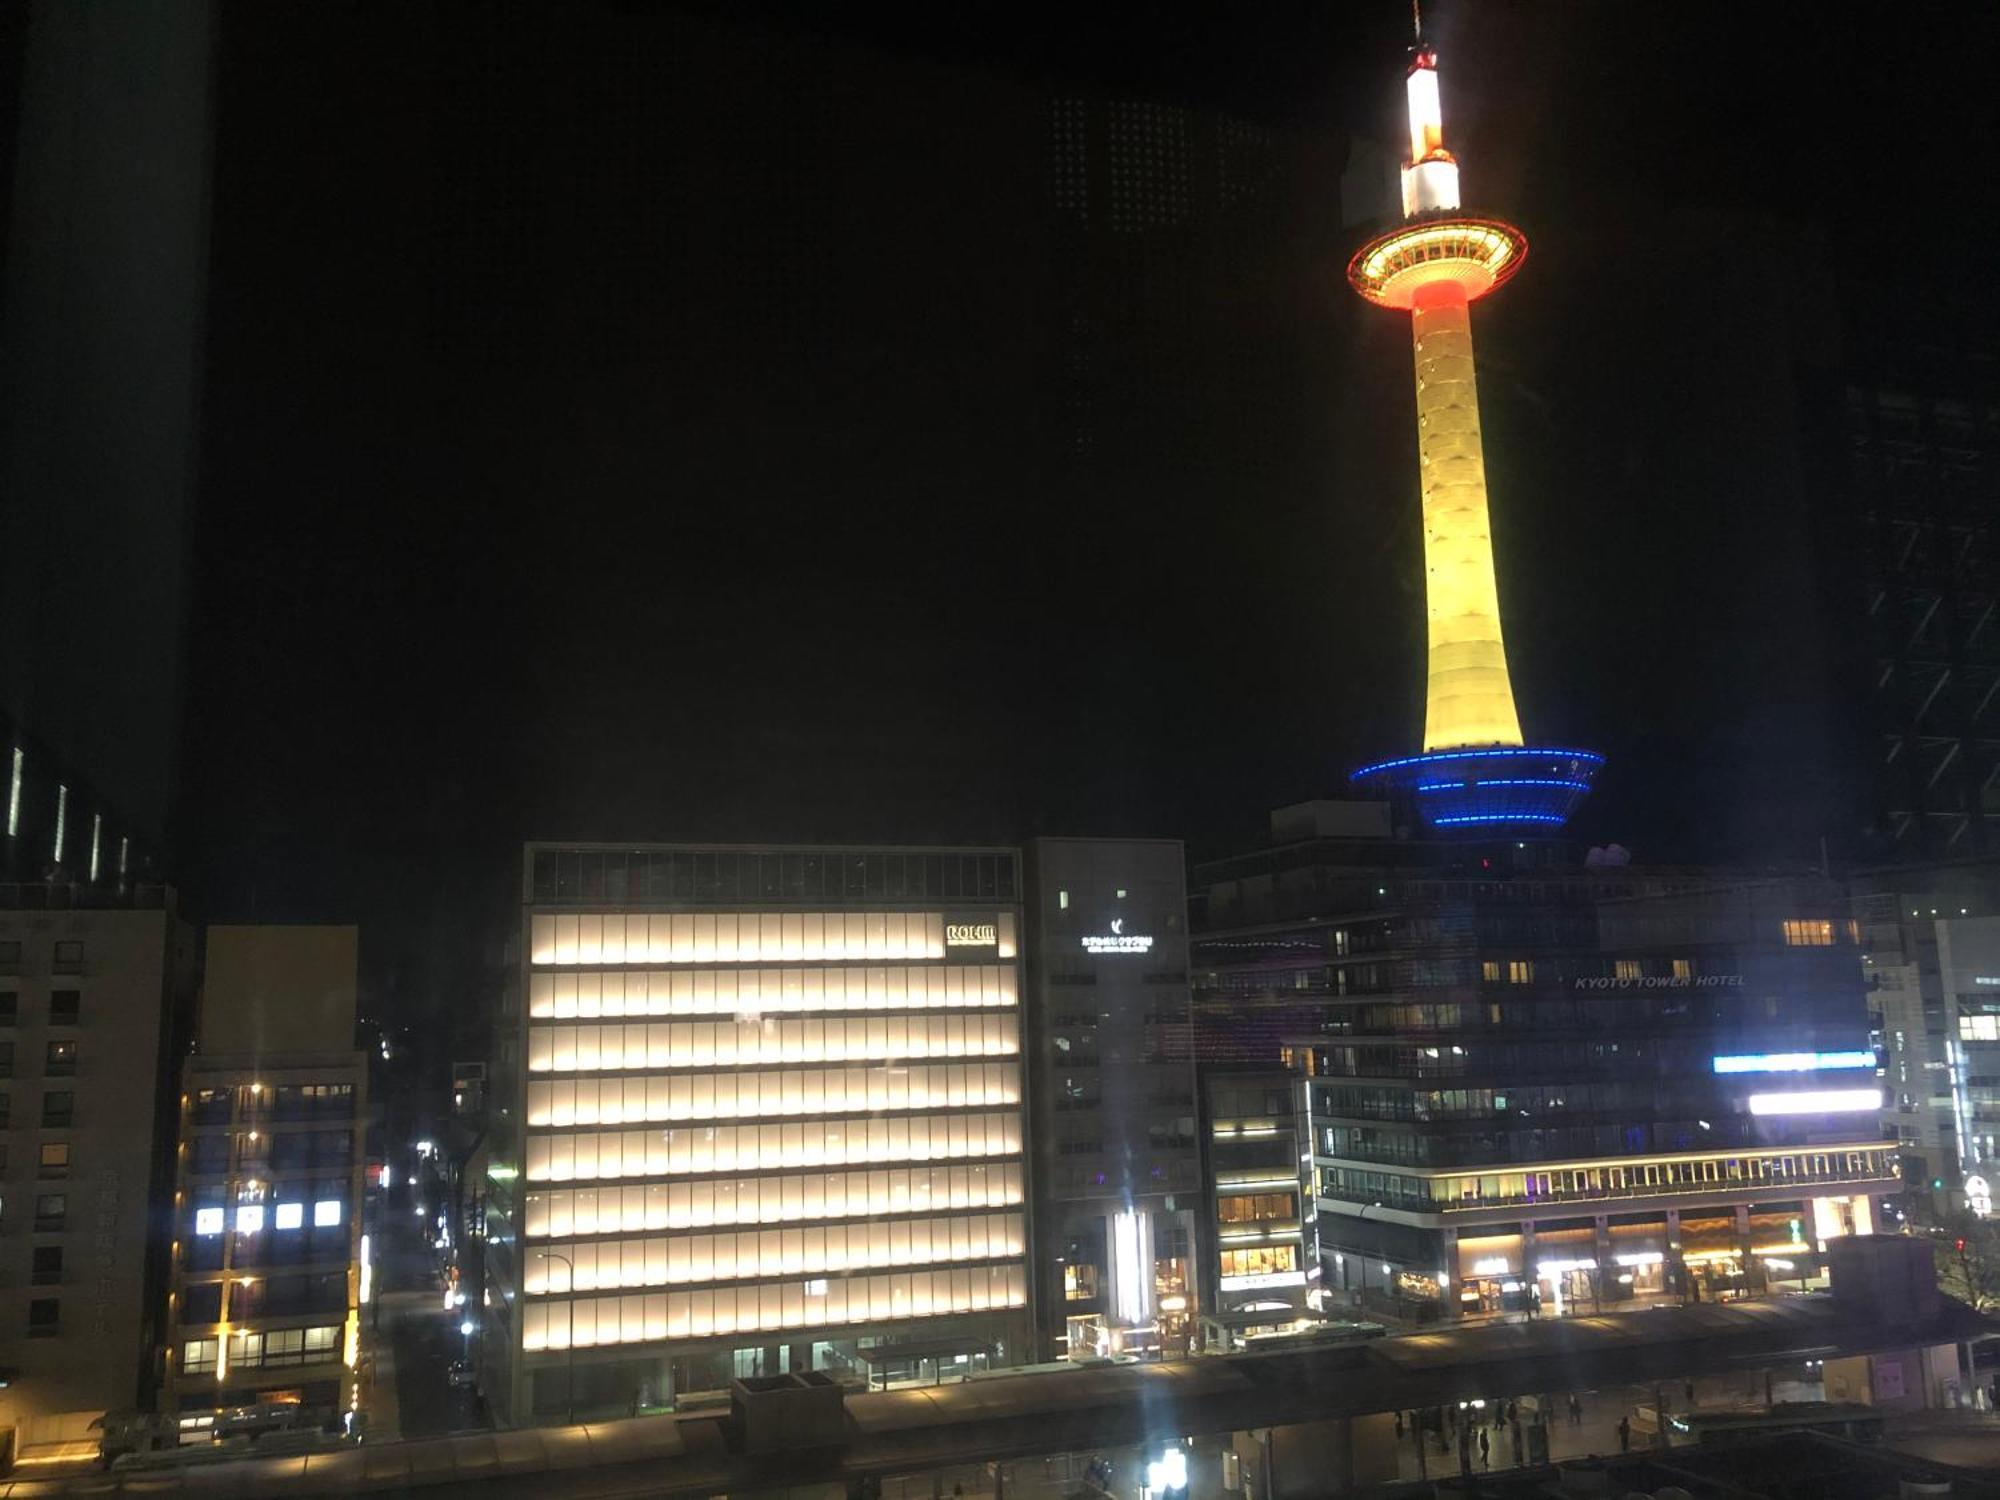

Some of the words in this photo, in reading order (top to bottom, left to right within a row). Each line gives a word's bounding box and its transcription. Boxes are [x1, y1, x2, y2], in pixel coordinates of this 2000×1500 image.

[947, 925, 996, 940] ROHM
[1575, 977, 1631, 989] KYOTO
[1636, 976, 1691, 988] TOWER
[1696, 975, 1746, 986] HOTEL
